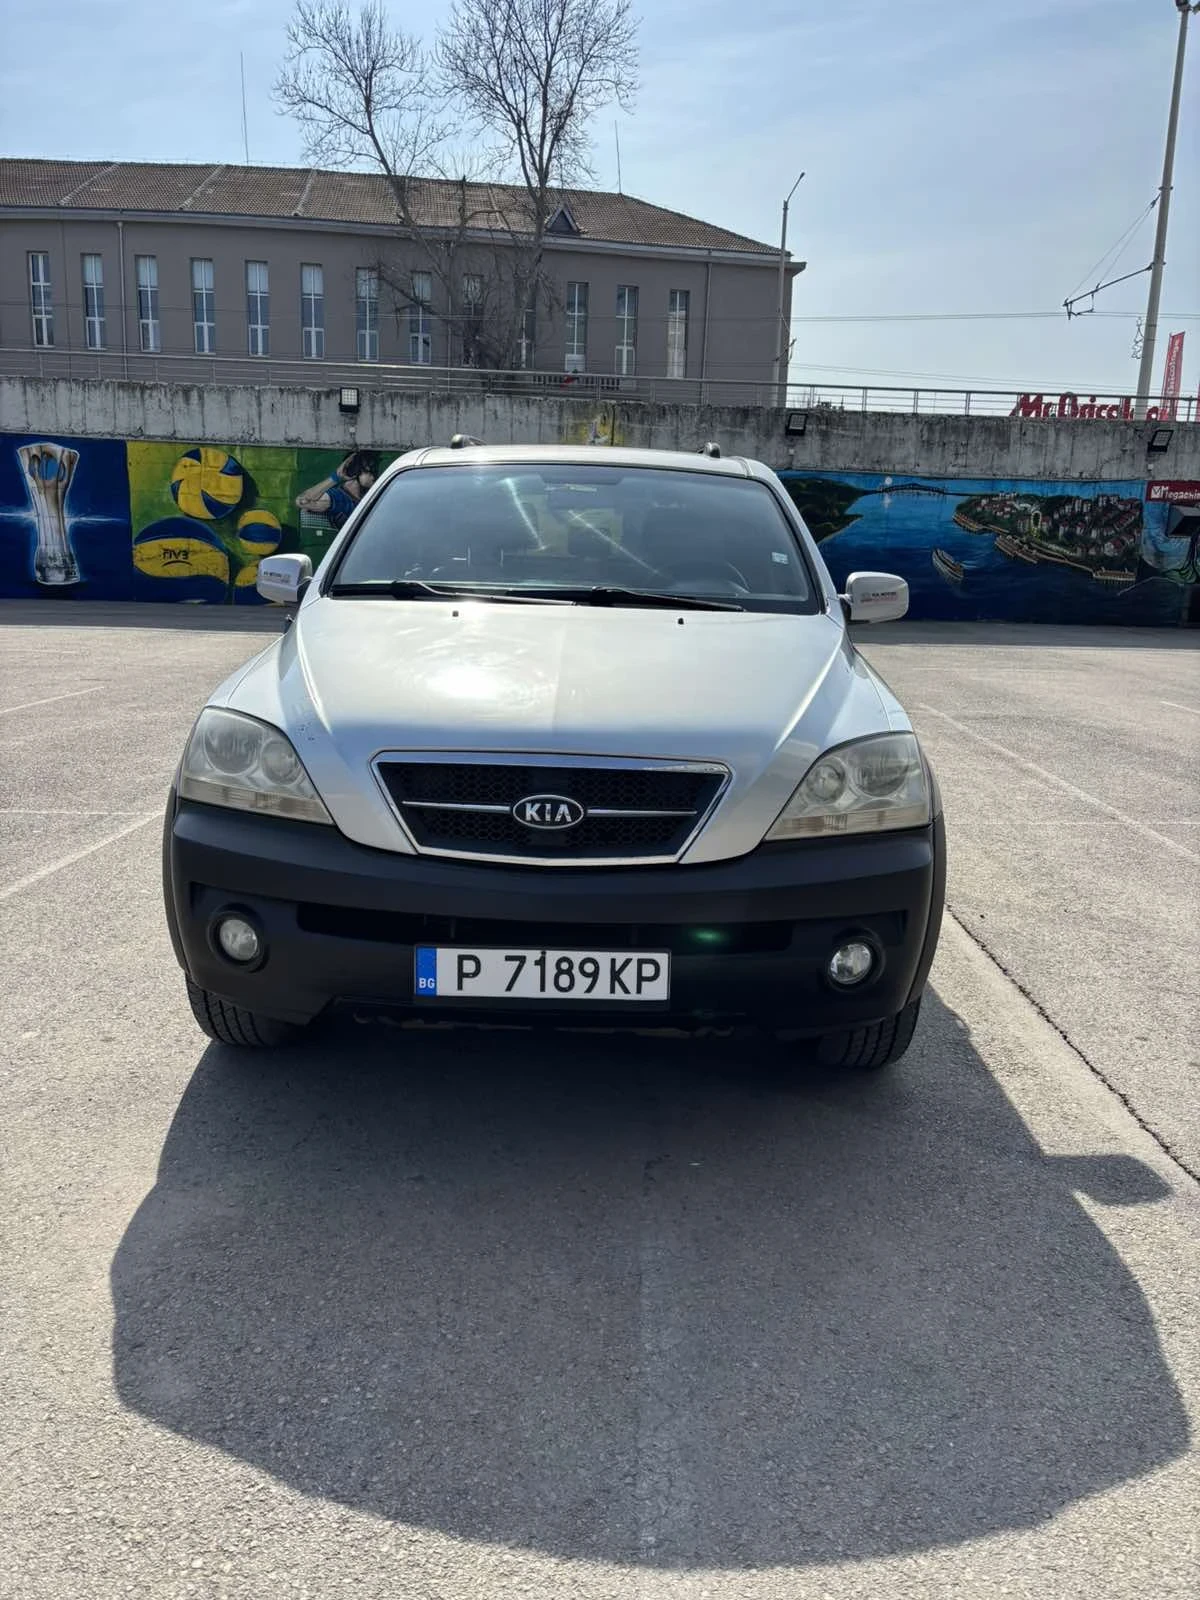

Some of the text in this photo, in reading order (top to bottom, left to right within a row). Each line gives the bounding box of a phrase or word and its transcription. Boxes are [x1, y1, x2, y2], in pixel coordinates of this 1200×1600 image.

[524, 803, 572, 822] KIA
[457, 954, 482, 991] P
[419, 978, 435, 989] BG
